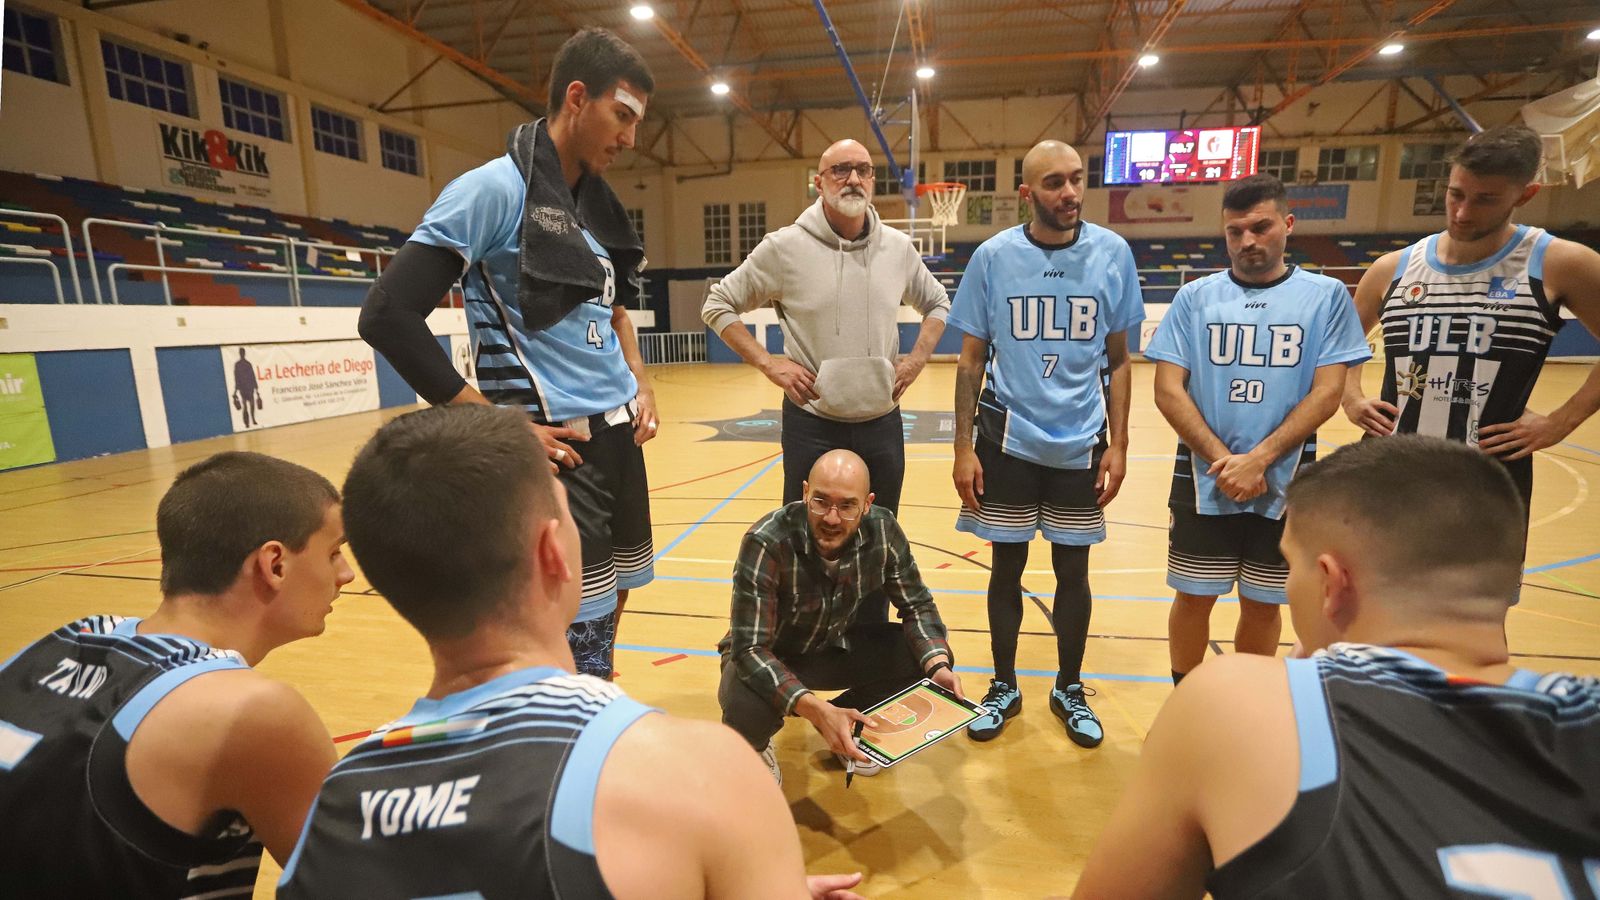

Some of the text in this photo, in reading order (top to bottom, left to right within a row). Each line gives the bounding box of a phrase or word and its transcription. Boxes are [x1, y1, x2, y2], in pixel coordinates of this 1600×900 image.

[1043, 268, 1065, 278] vive
[1244, 301, 1268, 309] vive
[1482, 302, 1511, 311] vive
[1007, 295, 1099, 341] ULB
[587, 320, 603, 349] 4
[1206, 323, 1304, 368] ULB
[1406, 315, 1497, 354] ULB
[256, 365, 273, 381] La
[327, 360, 341, 374] de
[343, 359, 373, 375] Diego
[1042, 353, 1059, 378] 7
[1229, 379, 1264, 403] 20
[360, 775, 481, 840] YOME
